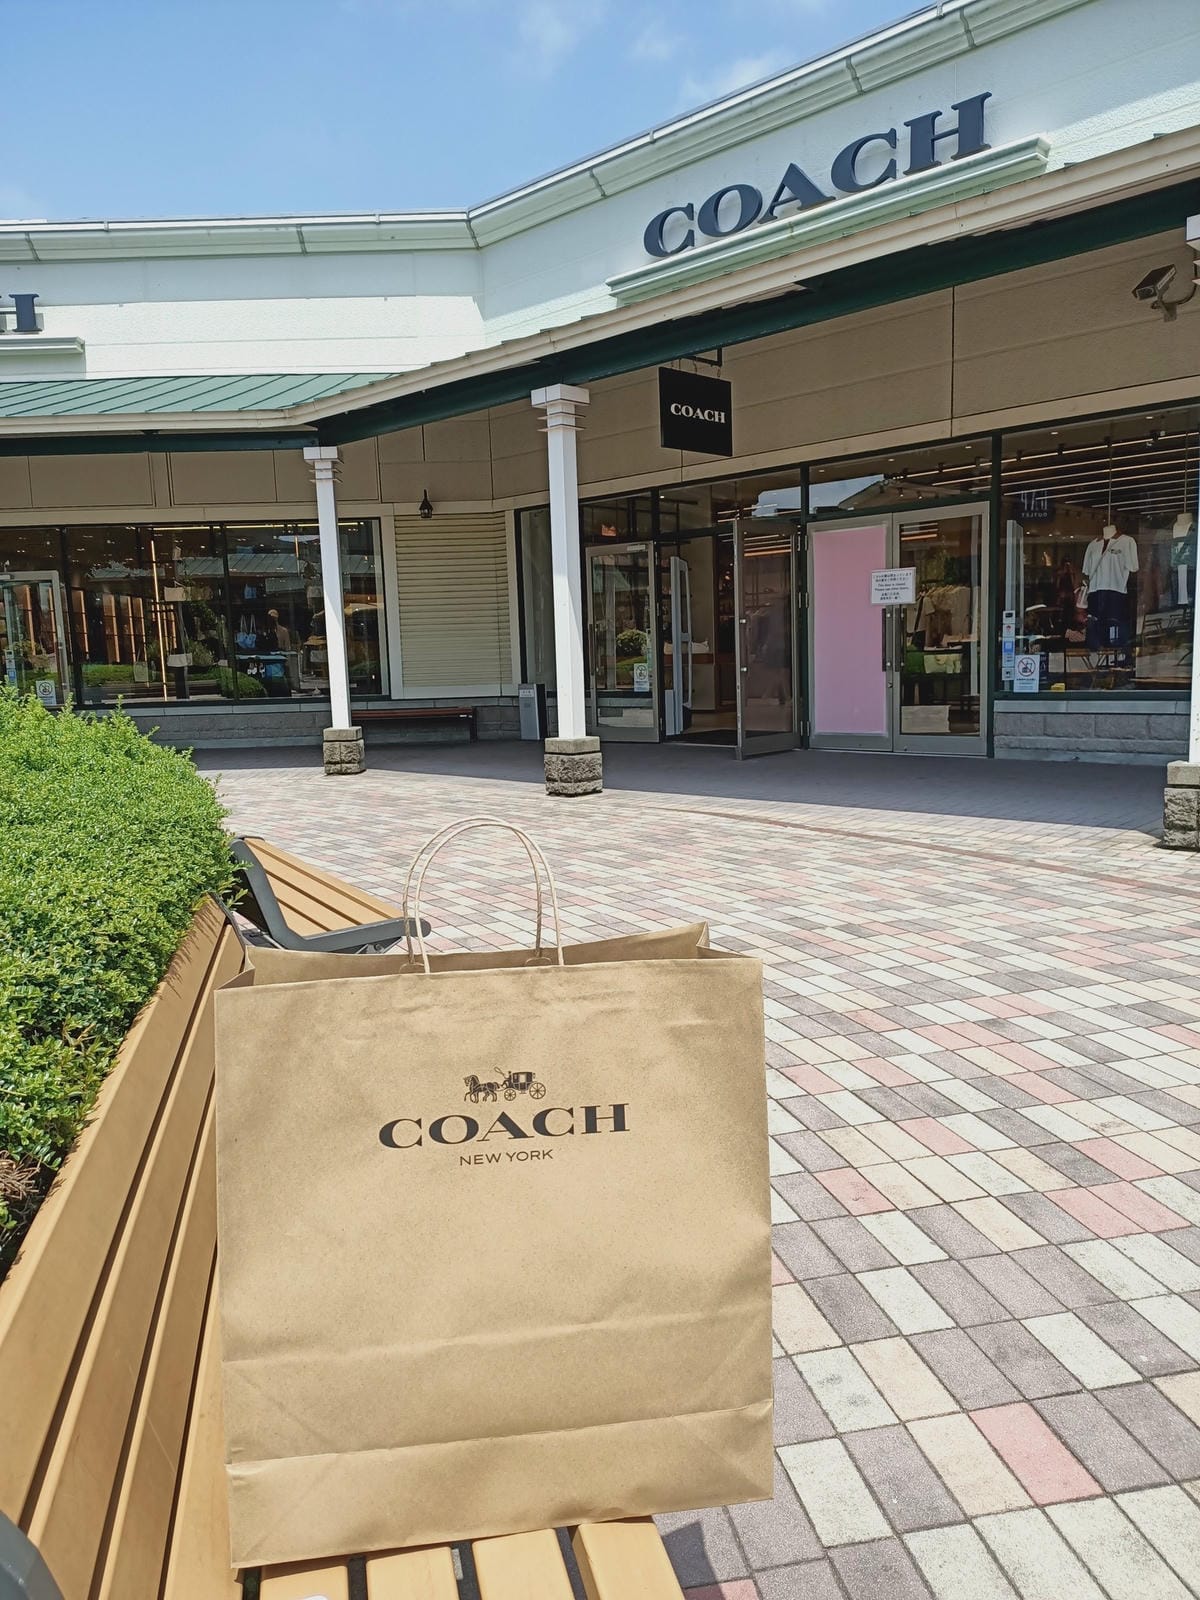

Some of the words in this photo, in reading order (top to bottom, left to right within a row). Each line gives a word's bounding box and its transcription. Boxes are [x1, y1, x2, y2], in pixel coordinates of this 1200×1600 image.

[643, 91, 993, 258] COACH
[670, 403, 726, 423] COACH
[378, 1103, 631, 1149] COACH
[459, 1152, 502, 1166] NEW
[505, 1149, 554, 1162] YORK
